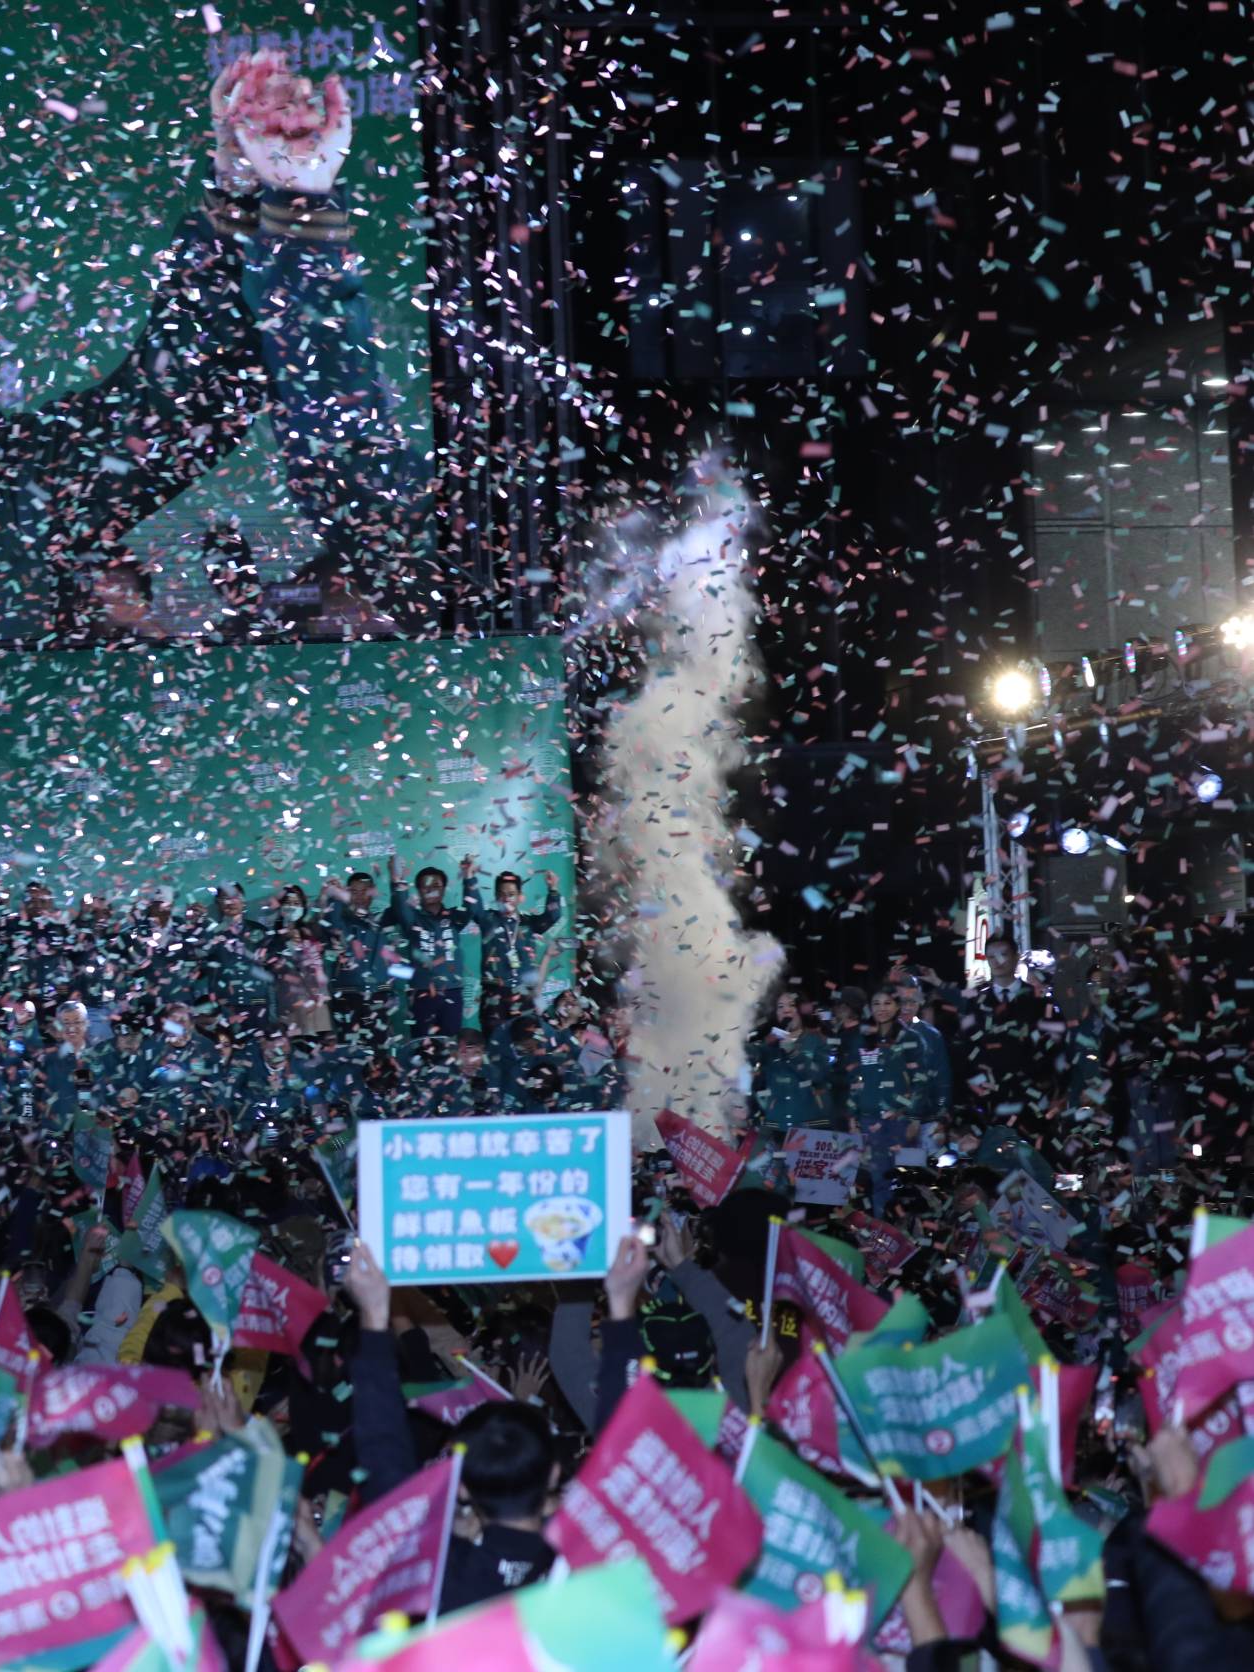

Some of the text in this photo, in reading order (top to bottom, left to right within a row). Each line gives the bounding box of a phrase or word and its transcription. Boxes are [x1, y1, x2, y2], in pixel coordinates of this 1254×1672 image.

[384, 1125, 604, 1162] 小英總統辛苦了
[400, 1167, 590, 1202] 您有一年份的
[391, 1206, 518, 1239] 鮮蝦魚板
[391, 1243, 485, 1273] 待領取
